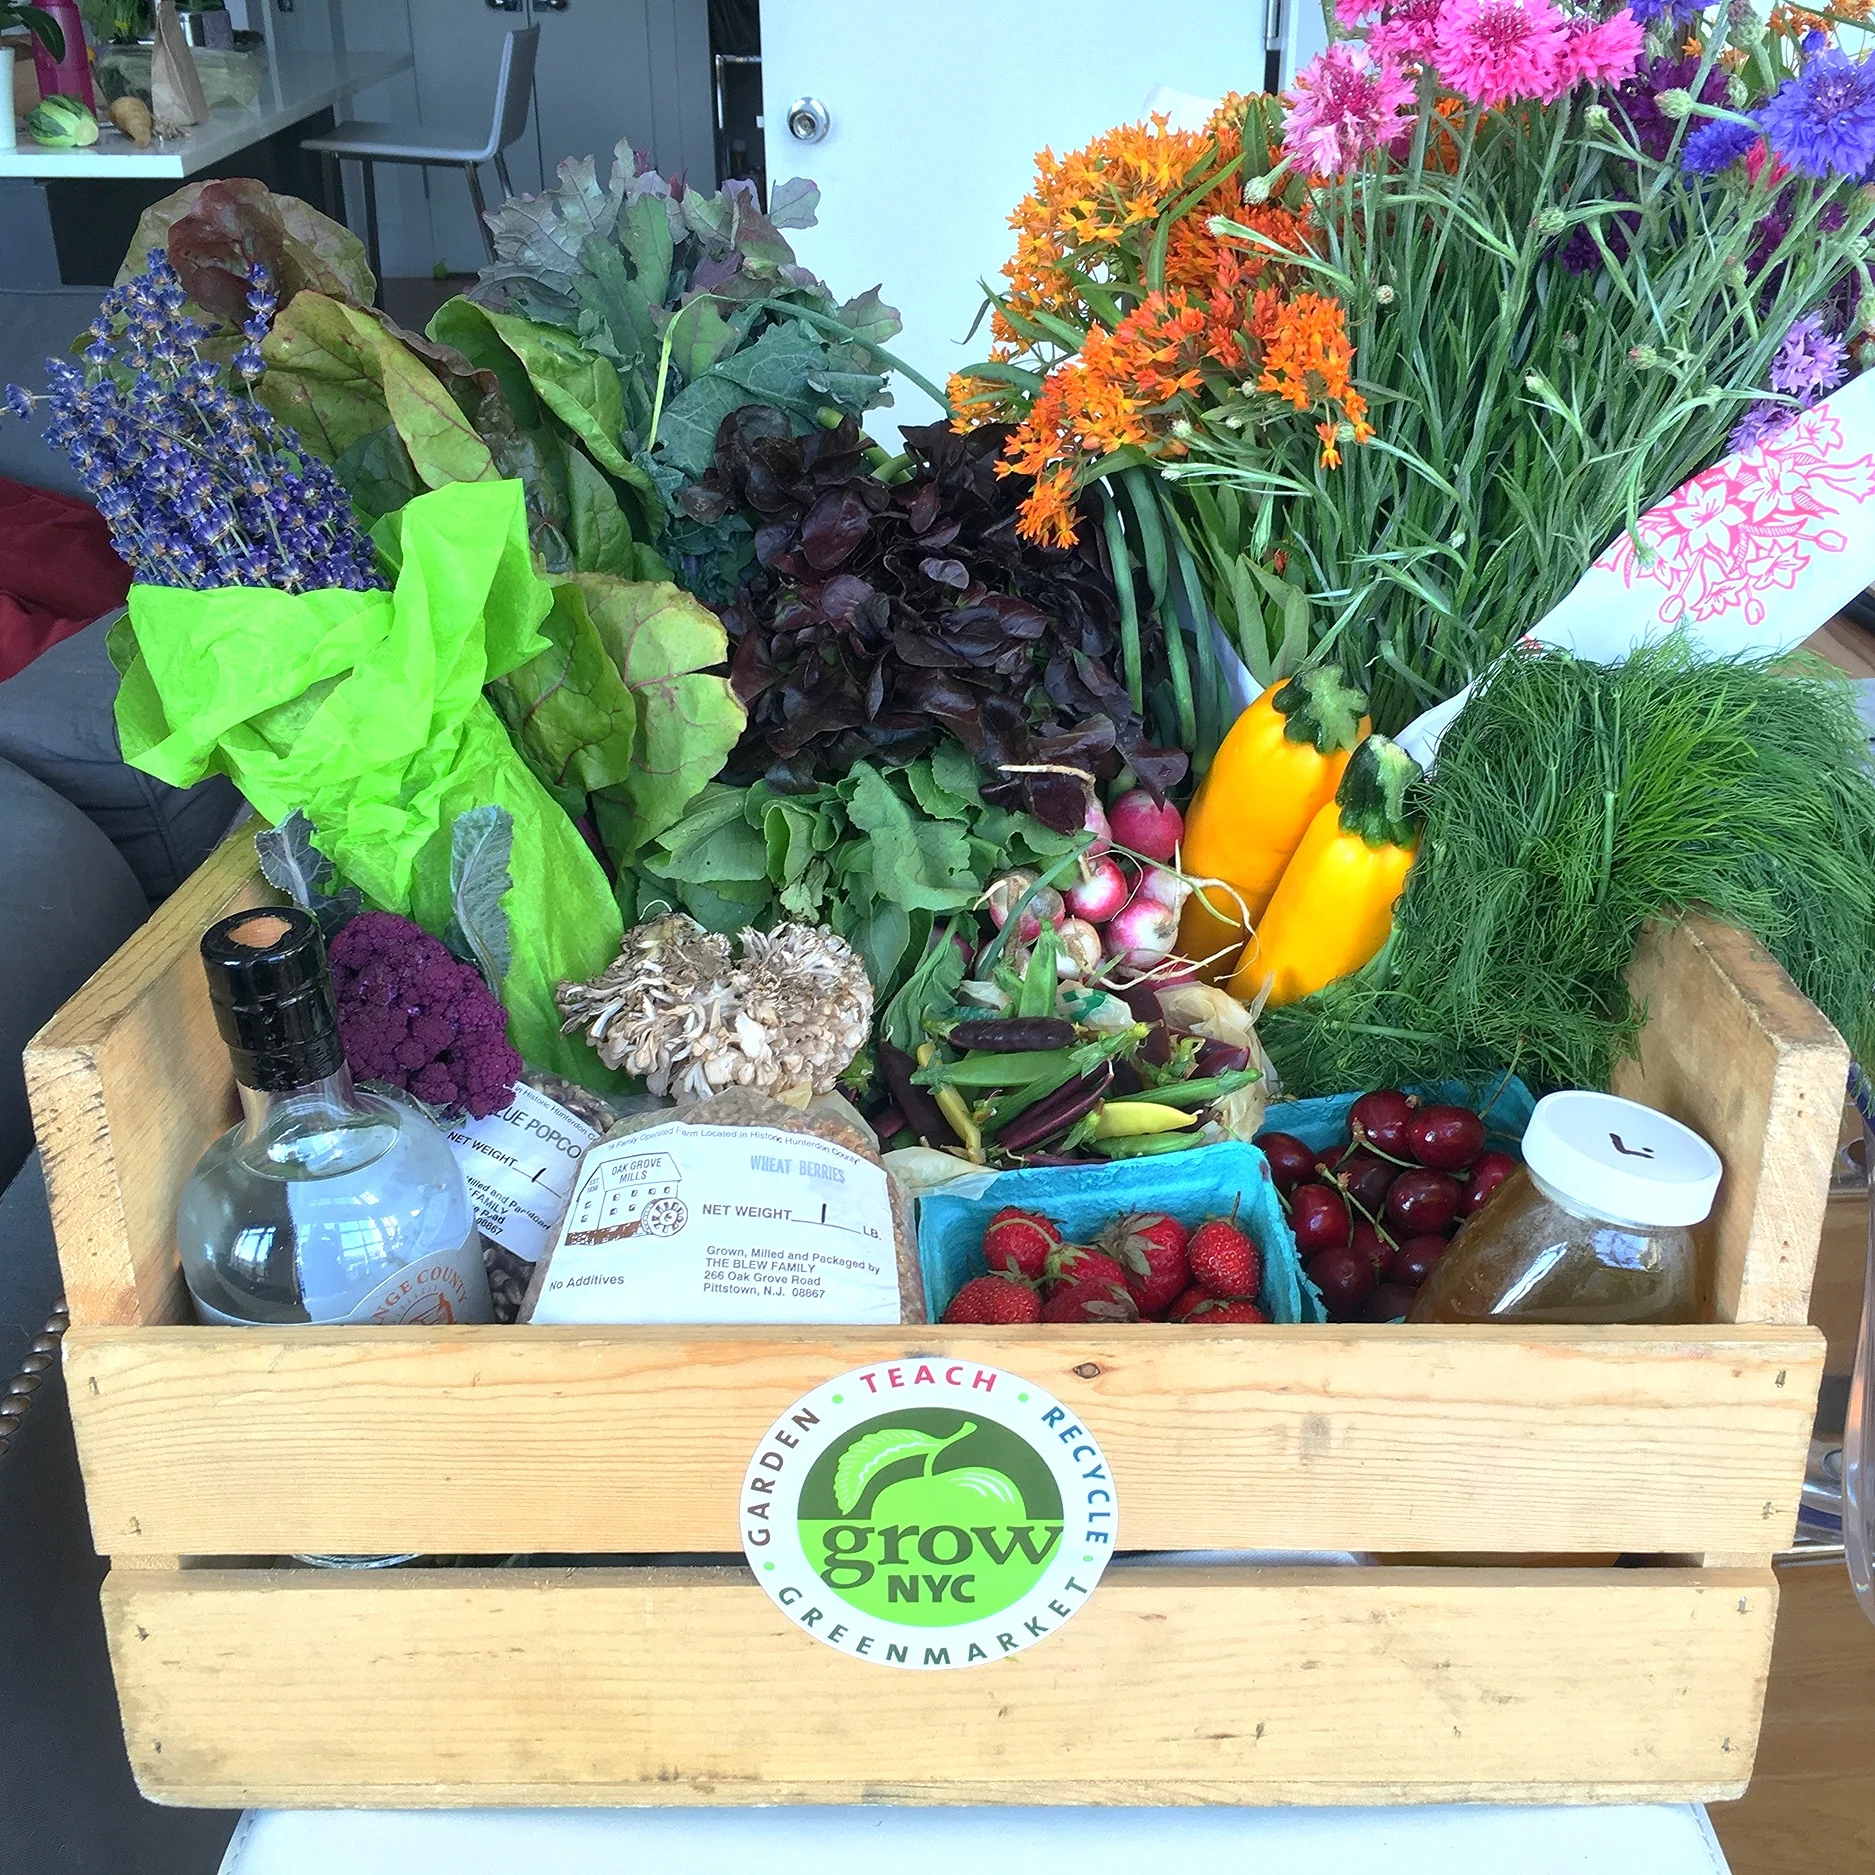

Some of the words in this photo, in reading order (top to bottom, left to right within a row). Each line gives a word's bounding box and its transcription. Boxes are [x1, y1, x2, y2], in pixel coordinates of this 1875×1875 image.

[522, 1089, 551, 1109] Historic
[550, 1105, 588, 1135] Hunterdon
[448, 1131, 472, 1146] NET
[471, 1139, 518, 1168] WEIGHT
[701, 1130, 737, 1138] Located
[750, 1131, 783, 1143] Historic
[785, 1136, 830, 1153] Hunterdon
[612, 1163, 629, 1176] OAK
[630, 1157, 662, 1171] GROVE
[619, 1170, 648, 1184] MILLS
[750, 1155, 792, 1175] WHEAT
[799, 1160, 846, 1184] BERRIES
[471, 1189, 508, 1215] FAMILY
[490, 1189, 509, 1204] and
[702, 1203, 731, 1216] NET
[735, 1205, 793, 1221] WEIGHT
[863, 1225, 882, 1241] LB.
[706, 1245, 748, 1258] Grown,
[751, 1247, 784, 1260] Milled
[787, 1251, 809, 1262] and
[812, 1252, 866, 1270] Packaged
[868, 1263, 881, 1276] by
[706, 1257, 730, 1269] THE
[733, 1259, 768, 1271] BLEW
[771, 1261, 816, 1274] FAMILY
[417, 1266, 469, 1304] COUNTY
[549, 1281, 564, 1293] No
[566, 1273, 625, 1289] Additives
[703, 1283, 760, 1297] Pittstown,
[763, 1285, 786, 1297] N.J.
[792, 1287, 825, 1299] 08867
[704, 1270, 725, 1281] 266
[728, 1270, 750, 1282] Oak
[753, 1272, 788, 1285] Grove
[791, 1274, 821, 1287] Road
[859, 1364, 998, 1394] TEACH
[747, 1406, 821, 1547] GARDEN
[1040, 1405, 1111, 1545] RECYCLE
[819, 1524, 1064, 1589] grow
[887, 1574, 976, 1604] NYC
[777, 1575, 1088, 1666] GREENMARKET
